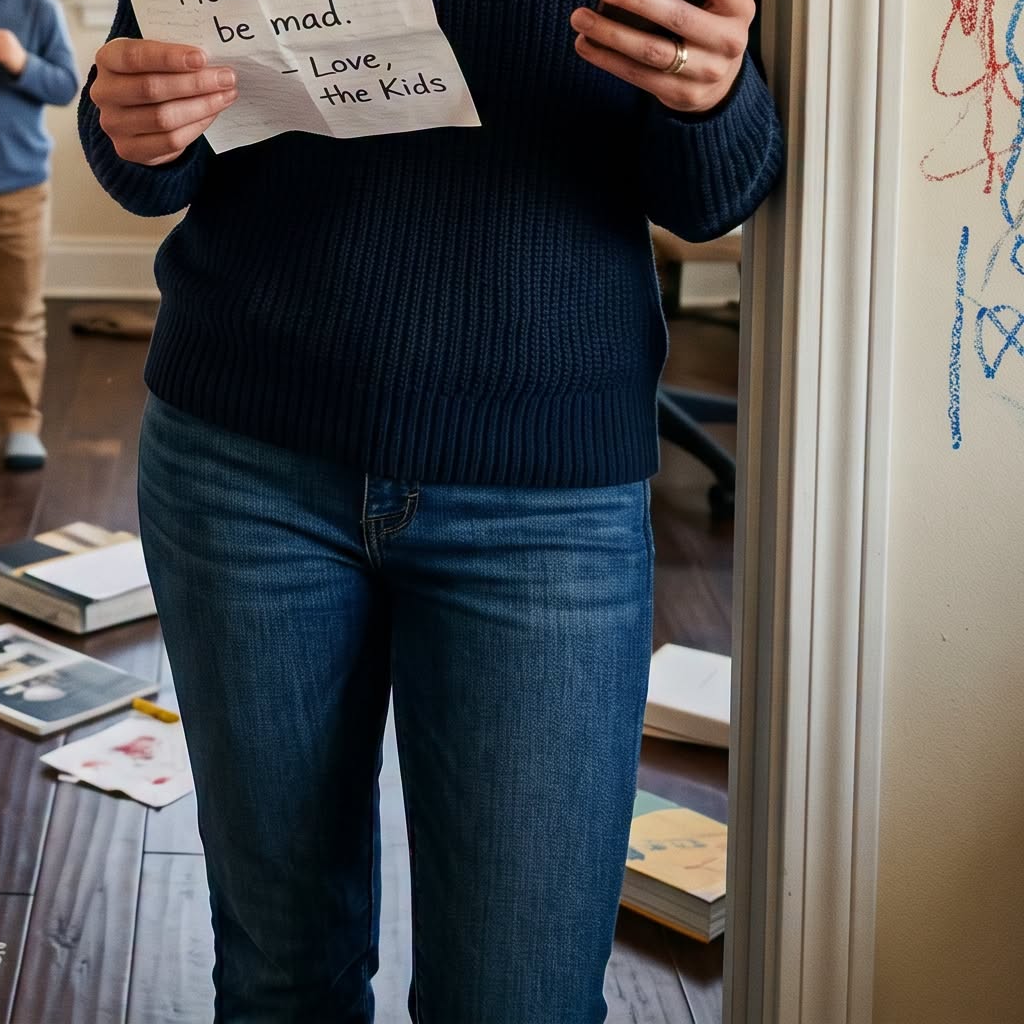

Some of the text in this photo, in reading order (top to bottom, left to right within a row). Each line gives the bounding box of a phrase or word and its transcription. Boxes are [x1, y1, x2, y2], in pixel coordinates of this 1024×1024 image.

[213, 16, 255, 43] be
[309, 51, 392, 78] Love,
[319, 73, 448, 106] the Kids
